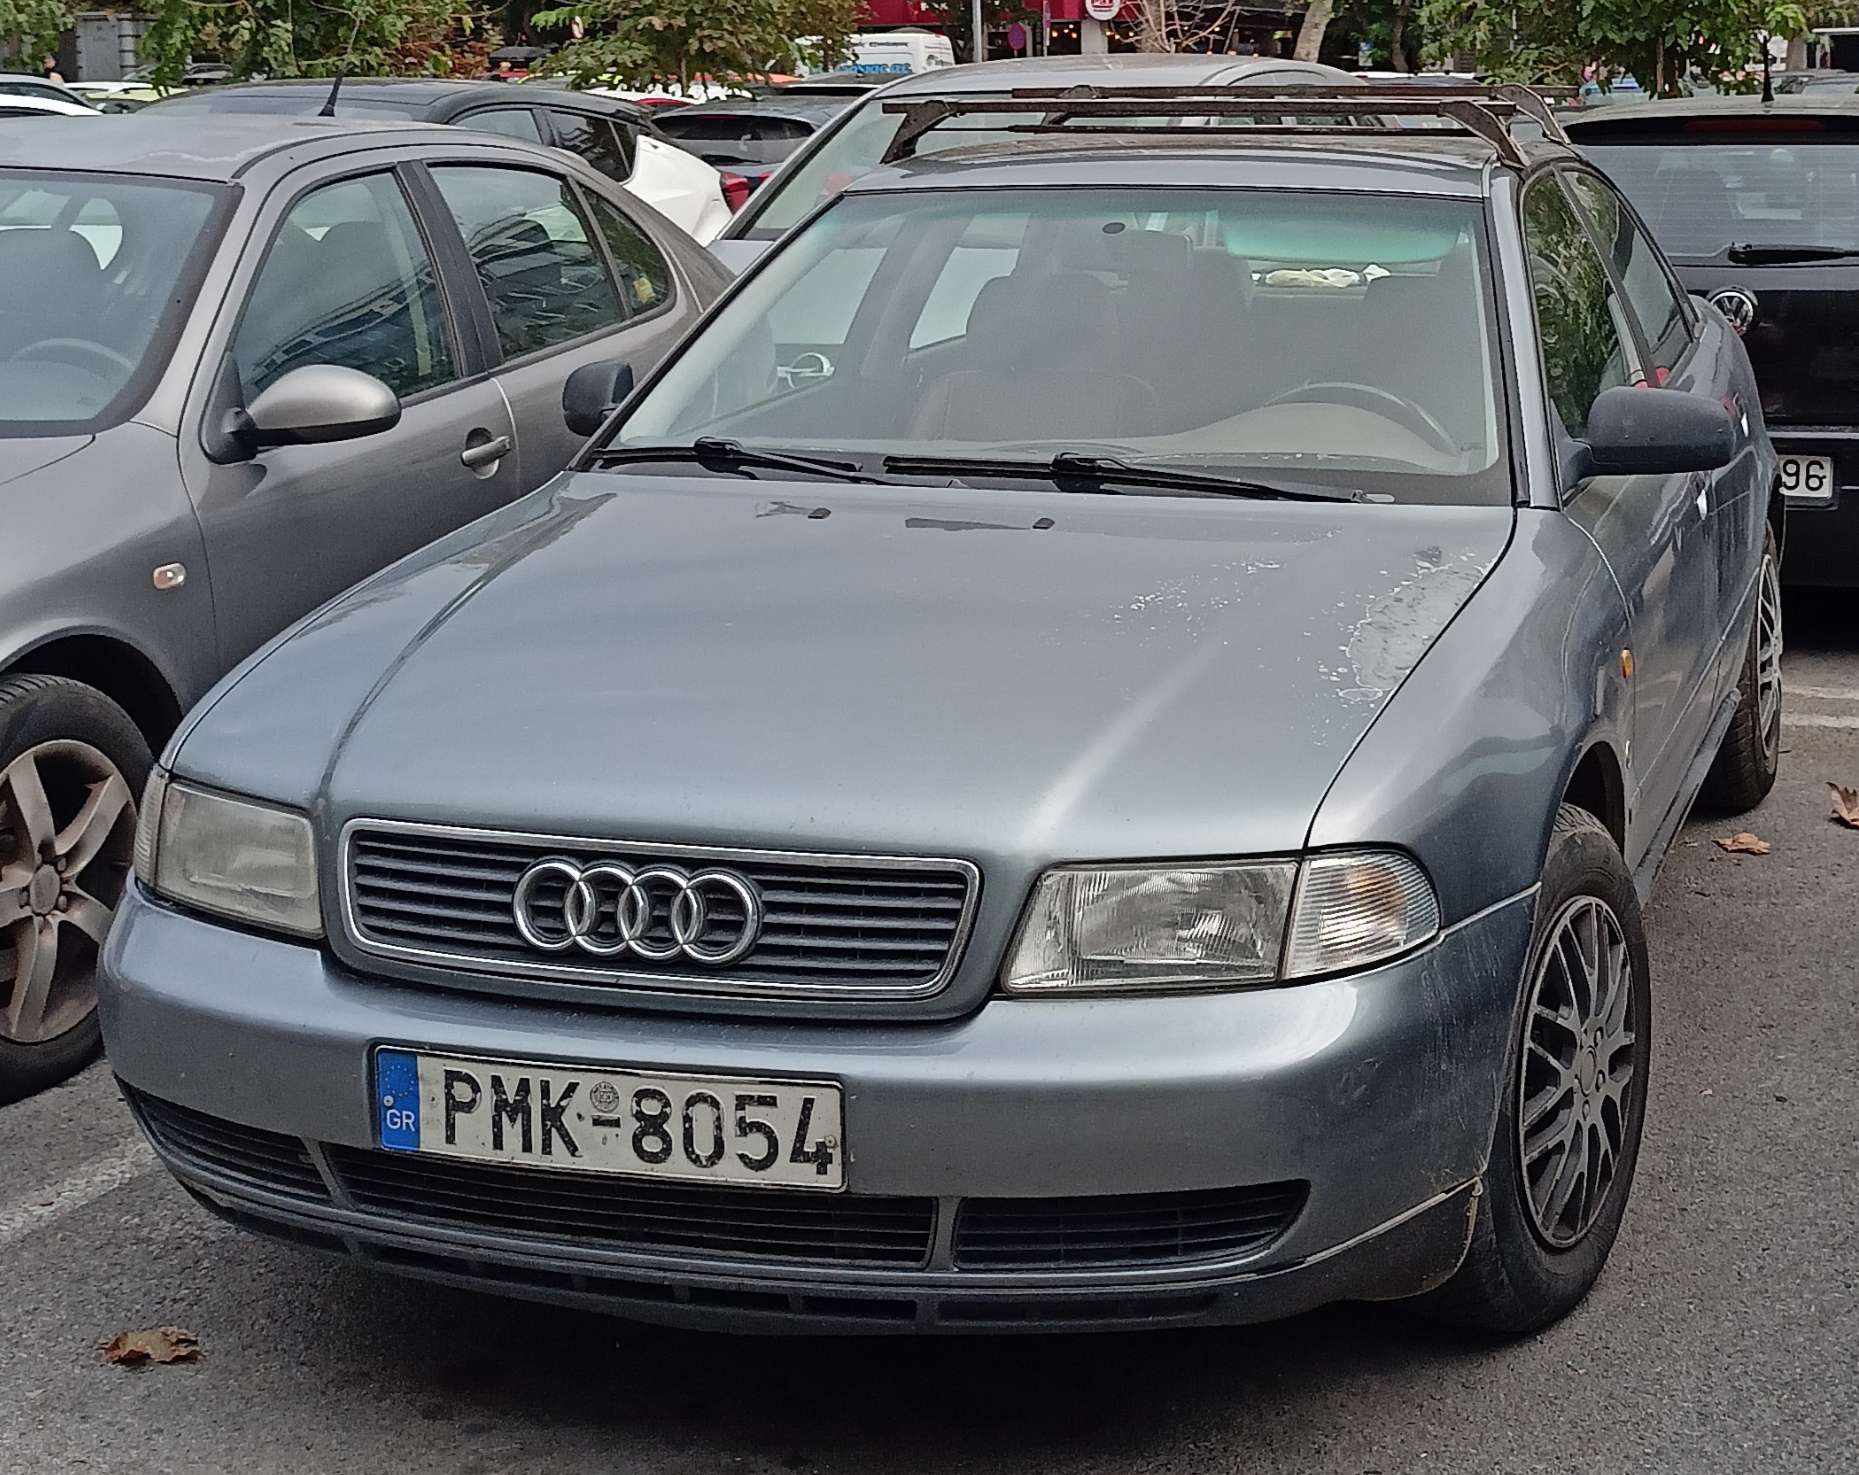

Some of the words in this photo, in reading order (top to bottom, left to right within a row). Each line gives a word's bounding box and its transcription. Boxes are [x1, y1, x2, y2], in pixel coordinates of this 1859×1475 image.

[1782, 458, 1827, 491] 96
[386, 1109, 415, 1132] GR
[443, 1068, 833, 1176] PMK-8054
